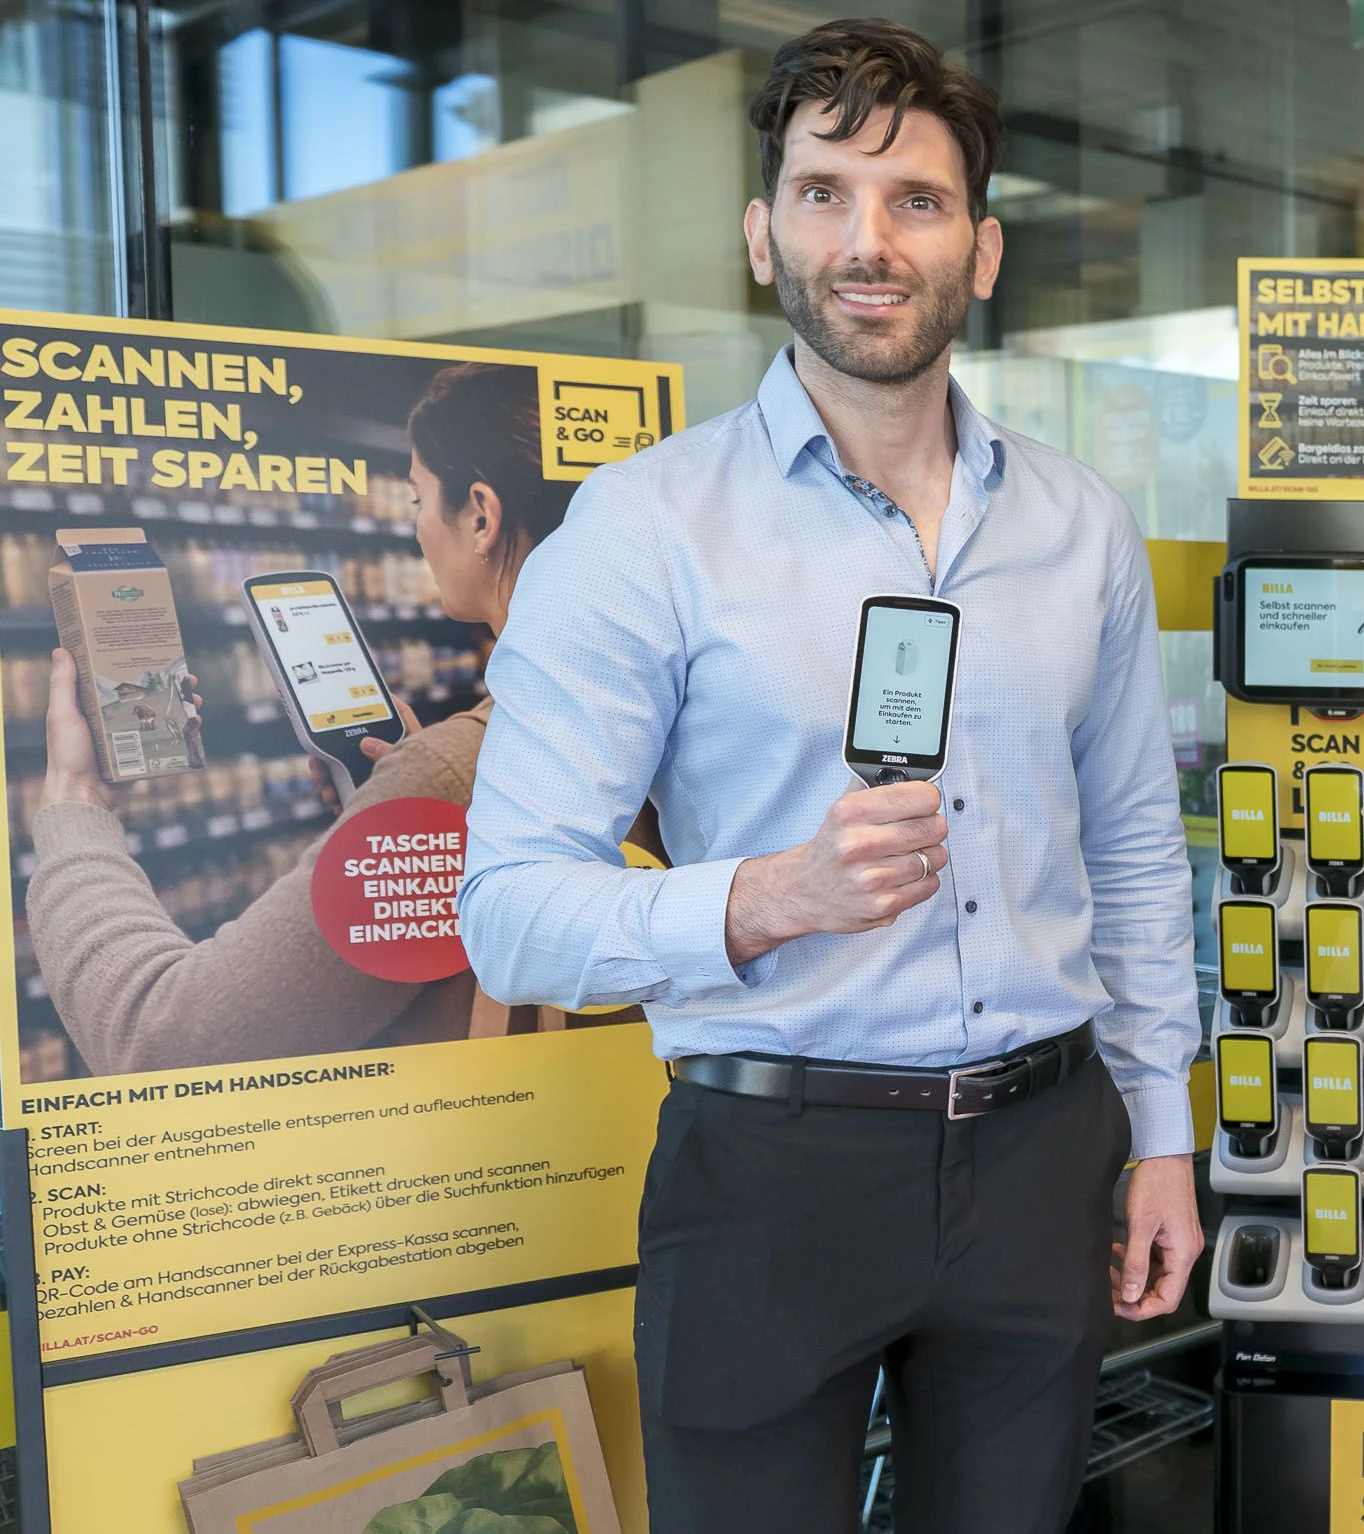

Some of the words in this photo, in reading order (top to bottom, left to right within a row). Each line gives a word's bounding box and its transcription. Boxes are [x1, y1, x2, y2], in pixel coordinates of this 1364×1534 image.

[1257, 312, 1312, 338] MIT
[1299, 349, 1322, 360] Alles
[1323, 350, 1337, 360] im
[0, 337, 304, 404] SCANNEN,
[1299, 395, 1319, 406] Zeit
[3, 390, 259, 450] ZAHLEN,
[554, 405, 609, 425] SCAN
[1299, 407, 1334, 417] Einkauf
[1335, 408, 1364, 417] direkt
[556, 426, 572, 443] &
[575, 427, 605, 445] GO
[6, 442, 138, 486] ZEIT
[150, 449, 367, 496] SPAREN
[1299, 454, 1328, 465] Direkt
[1344, 455, 1361, 465] der
[1262, 583, 1293, 594] BILLA
[1260, 600, 1291, 610] Selbst
[1293, 602, 1336, 611] scannen
[1260, 611, 1280, 620] und
[1282, 612, 1327, 621] schneller
[1259, 621, 1310, 631] einkaufen
[895, 690, 922, 698] Produkt
[878, 711, 912, 719] Einkaufen
[1291, 733, 1360, 754] SCAN
[882, 755, 908, 764] ZEBRA
[1231, 809, 1264, 821] BILLA
[1318, 811, 1351, 823] BILLA
[366, 832, 461, 854] TASCHE
[344, 854, 463, 877] SCANNEN
[374, 897, 459, 920] DIREKT
[349, 919, 462, 944] EINPACK
[1231, 943, 1264, 954] BILLA
[1318, 946, 1350, 957] BILLA
[22, 1090, 122, 1114] EINFACH
[129, 1085, 168, 1103] MIT
[175, 1080, 223, 1098] DEM
[230, 1062, 396, 1092] HANDSCANNER:
[1230, 1075, 1262, 1086] BILLA
[1312, 1076, 1352, 1090] BILLA
[28, 1142, 88, 1159] Screen
[94, 1134, 121, 1151] bei
[126, 1131, 157, 1148] der
[162, 1117, 281, 1145] Ausgabestelle
[286, 1108, 375, 1130] entsperren
[379, 1102, 409, 1118] und
[413, 1090, 535, 1114] aufleuchtenden
[41, 1121, 103, 1140] START:
[28, 1153, 150, 1176] Handscanner
[154, 1140, 255, 1161] entnehmen
[43, 1198, 126, 1221] Produkte
[131, 1194, 161, 1210] mit
[165, 1182, 259, 1206] Strichcode
[264, 1173, 313, 1192] direkt
[317, 1166, 385, 1184] scannen
[43, 1219, 89, 1238] Obst
[93, 1217, 108, 1231] &
[111, 1209, 186, 1230] Gemüse
[190, 1203, 233, 1222] (lose):
[238, 1190, 326, 1213] abwiegen,
[330, 1180, 383, 1199] Etikett
[387, 1173, 451, 1192] drucken
[454, 1167, 483, 1182] und
[487, 1160, 551, 1178] scannen
[47, 1183, 107, 1202] SCAN:
[44, 1232, 128, 1256] Produkte
[133, 1228, 178, 1244] ohne
[182, 1211, 276, 1236] Strichcode
[312, 1200, 372, 1219] Gebäck)
[375, 1193, 412, 1210] über
[417, 1188, 441, 1204] die
[444, 1174, 543, 1200] Suchfunktion
[545, 1164, 625, 1186] hinzufügen
[1315, 1209, 1347, 1220] BILLA
[37, 1279, 119, 1304] QR-Code
[123, 1276, 153, 1290] am
[158, 1257, 273, 1285] Handscanner
[277, 1250, 302, 1268] bei
[306, 1245, 333, 1261] der
[338, 1230, 449, 1258] Express-Kassa
[452, 1220, 520, 1240] scannen,
[120, 1294, 134, 1307] &
[138, 1277, 253, 1305] Handscanner
[258, 1271, 283, 1287] bei
[288, 1266, 316, 1282] der
[319, 1243, 453, 1277] Rückgabestation
[455, 1235, 525, 1256] abgeben
[51, 1266, 90, 1283] PAY:
[42, 1324, 158, 1351] ILLA.AT/SCAN-GO
